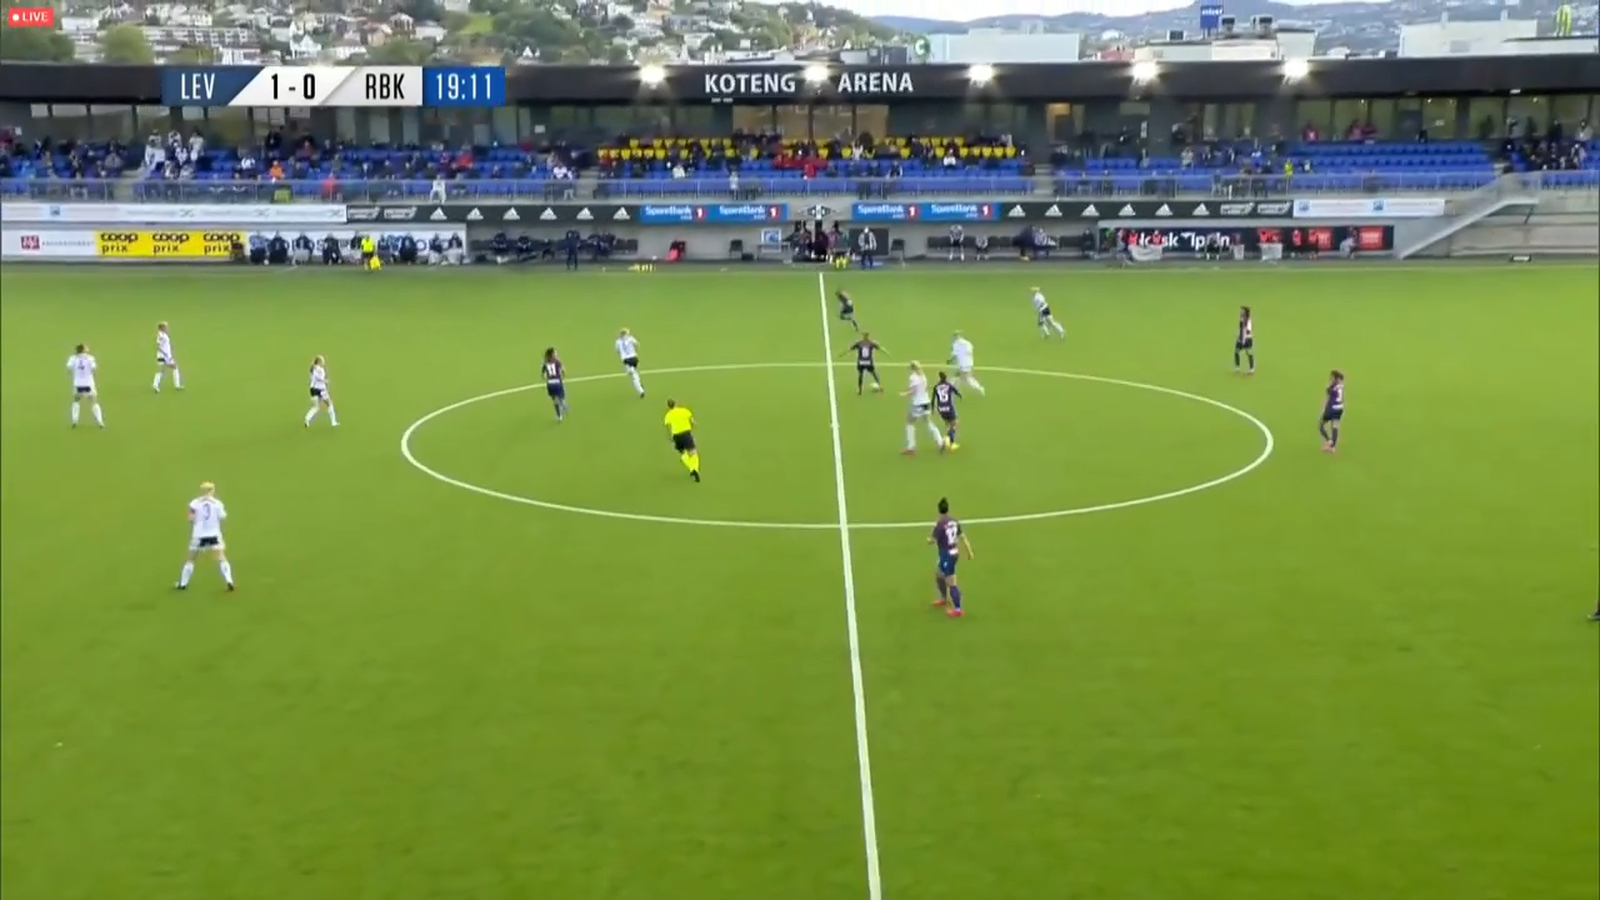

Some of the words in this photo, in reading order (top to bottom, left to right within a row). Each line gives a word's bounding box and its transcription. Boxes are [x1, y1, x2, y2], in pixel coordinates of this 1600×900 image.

[704, 72, 797, 94] KOTENG
[837, 71, 915, 93] ARENA
[101, 231, 139, 244] coop
[152, 231, 190, 244] coop
[203, 231, 241, 244] coop
[102, 243, 129, 255] prix
[152, 243, 180, 255] prix
